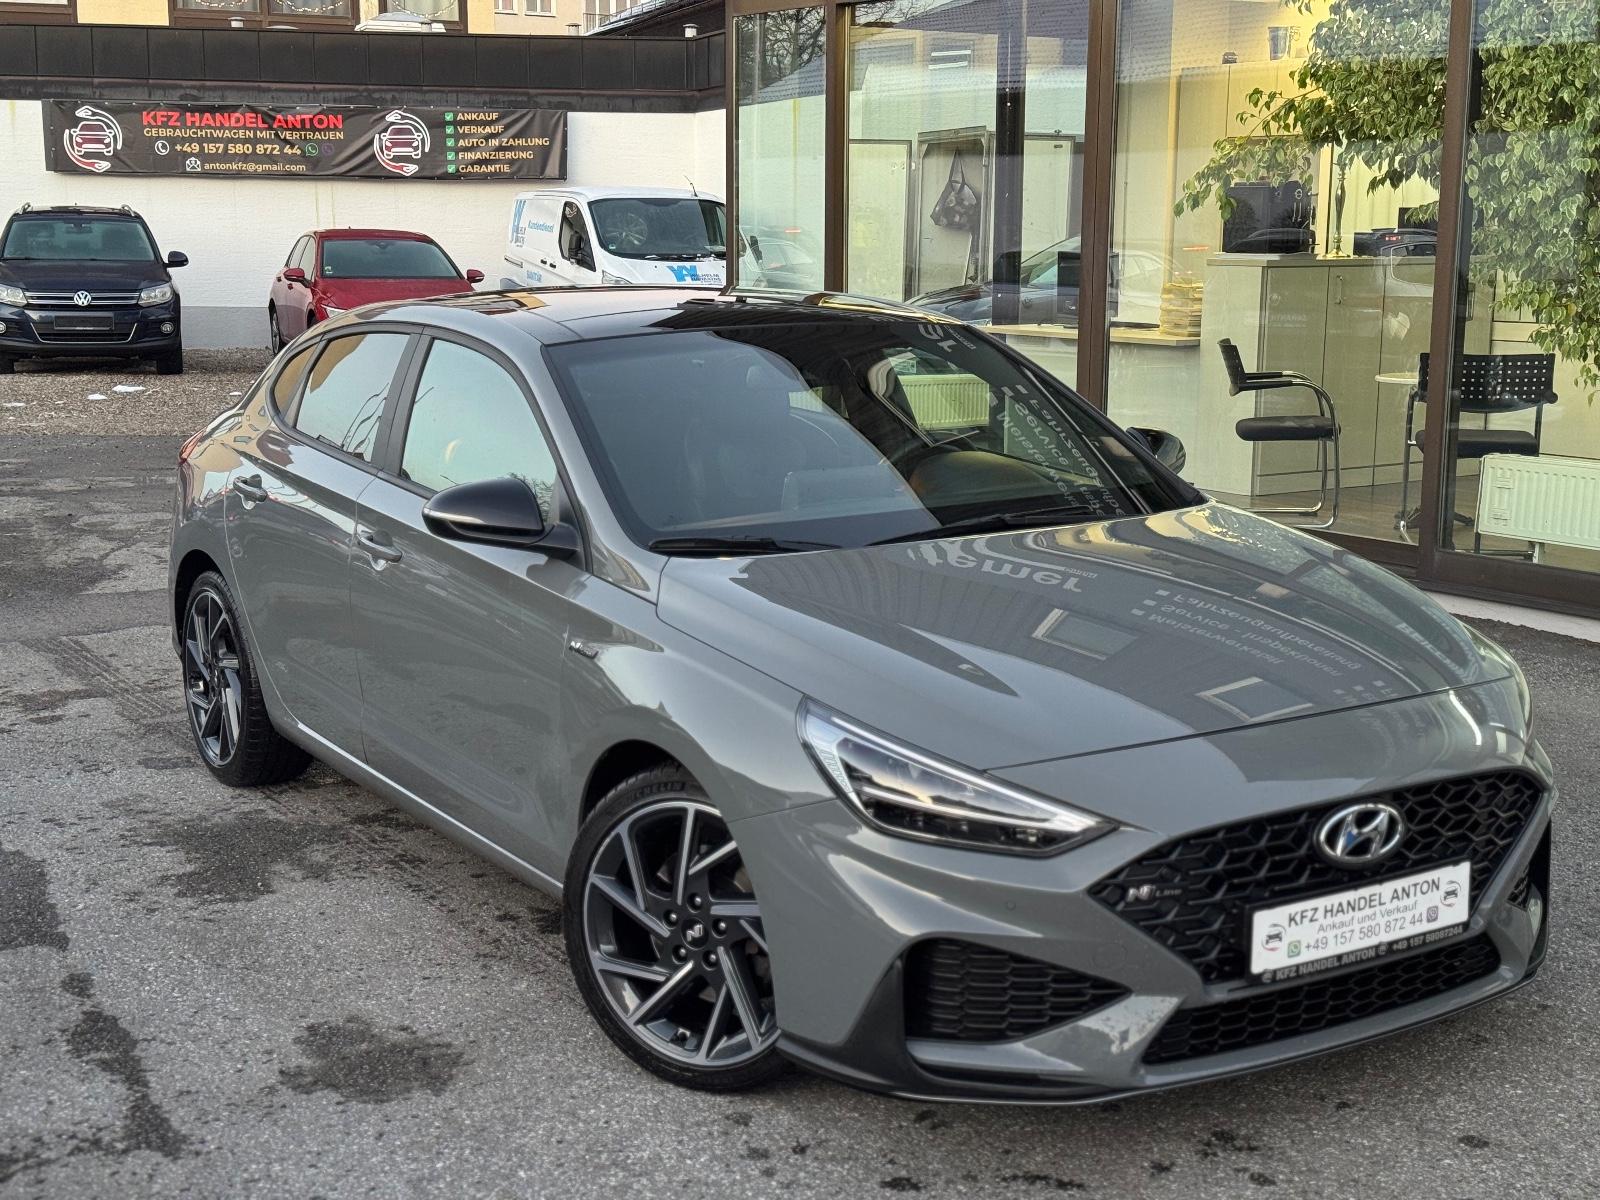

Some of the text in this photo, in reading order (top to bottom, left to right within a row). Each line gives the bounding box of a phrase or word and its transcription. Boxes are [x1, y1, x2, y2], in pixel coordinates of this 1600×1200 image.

[142, 111, 343, 129] KFZ HANDEL ANTON
[457, 112, 499, 121] ANKAUF
[143, 127, 344, 140] GEBRAUCHTWAGEN MIT VERTRAUEN
[457, 125, 504, 134] VERKAUF
[457, 137, 550, 147] AUTO IN ZAHLUNG
[174, 143, 302, 156] +49 157 580 872 44
[458, 151, 534, 160] FINANZIERUNG
[203, 162, 306, 173] antonkfz@gmail.com
[458, 164, 511, 173] GARANTIE
[1288, 877, 1441, 927] KFZ HANDEL ANTON
[1317, 901, 1419, 934] Ankauf und Verkauf
[1305, 911, 1423, 953] +49 157 580 872 44
[1275, 966, 1297, 981] KFZ
[1299, 957, 1339, 975] HANDEL
[1341, 948, 1376, 966] ANTON
